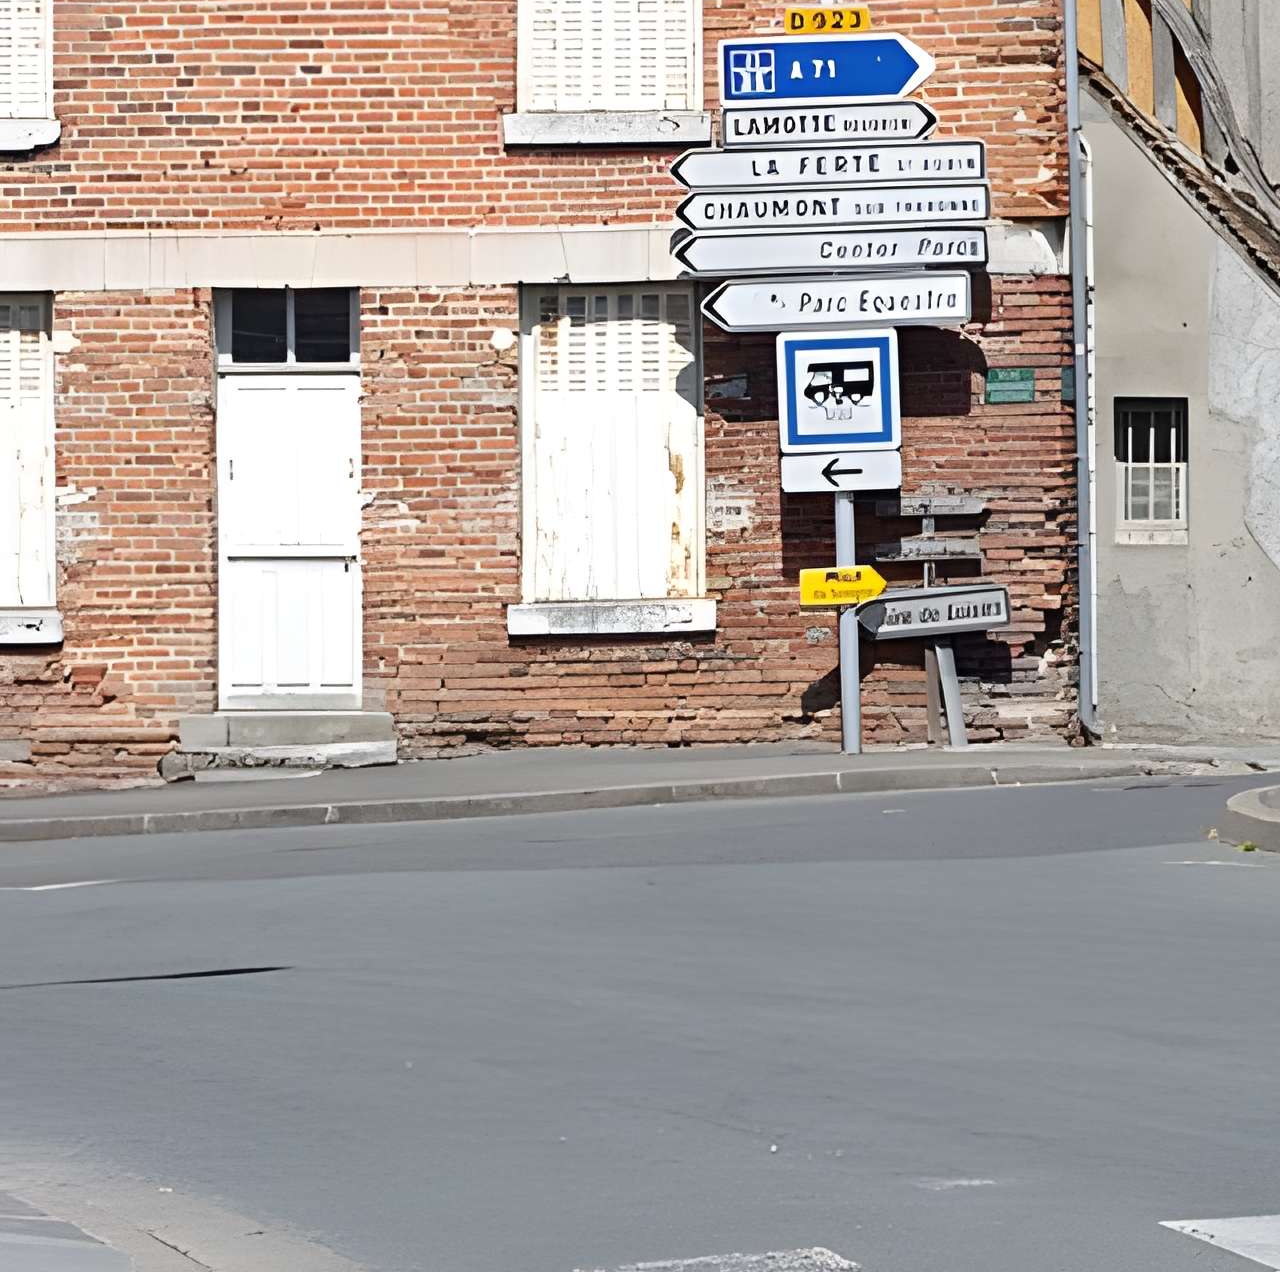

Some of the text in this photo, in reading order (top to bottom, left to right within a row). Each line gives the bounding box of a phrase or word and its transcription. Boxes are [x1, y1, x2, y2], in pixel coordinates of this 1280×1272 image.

[790, 61, 803, 79] A
[752, 159, 779, 176] LA
[704, 198, 840, 220] CHAUMONT
